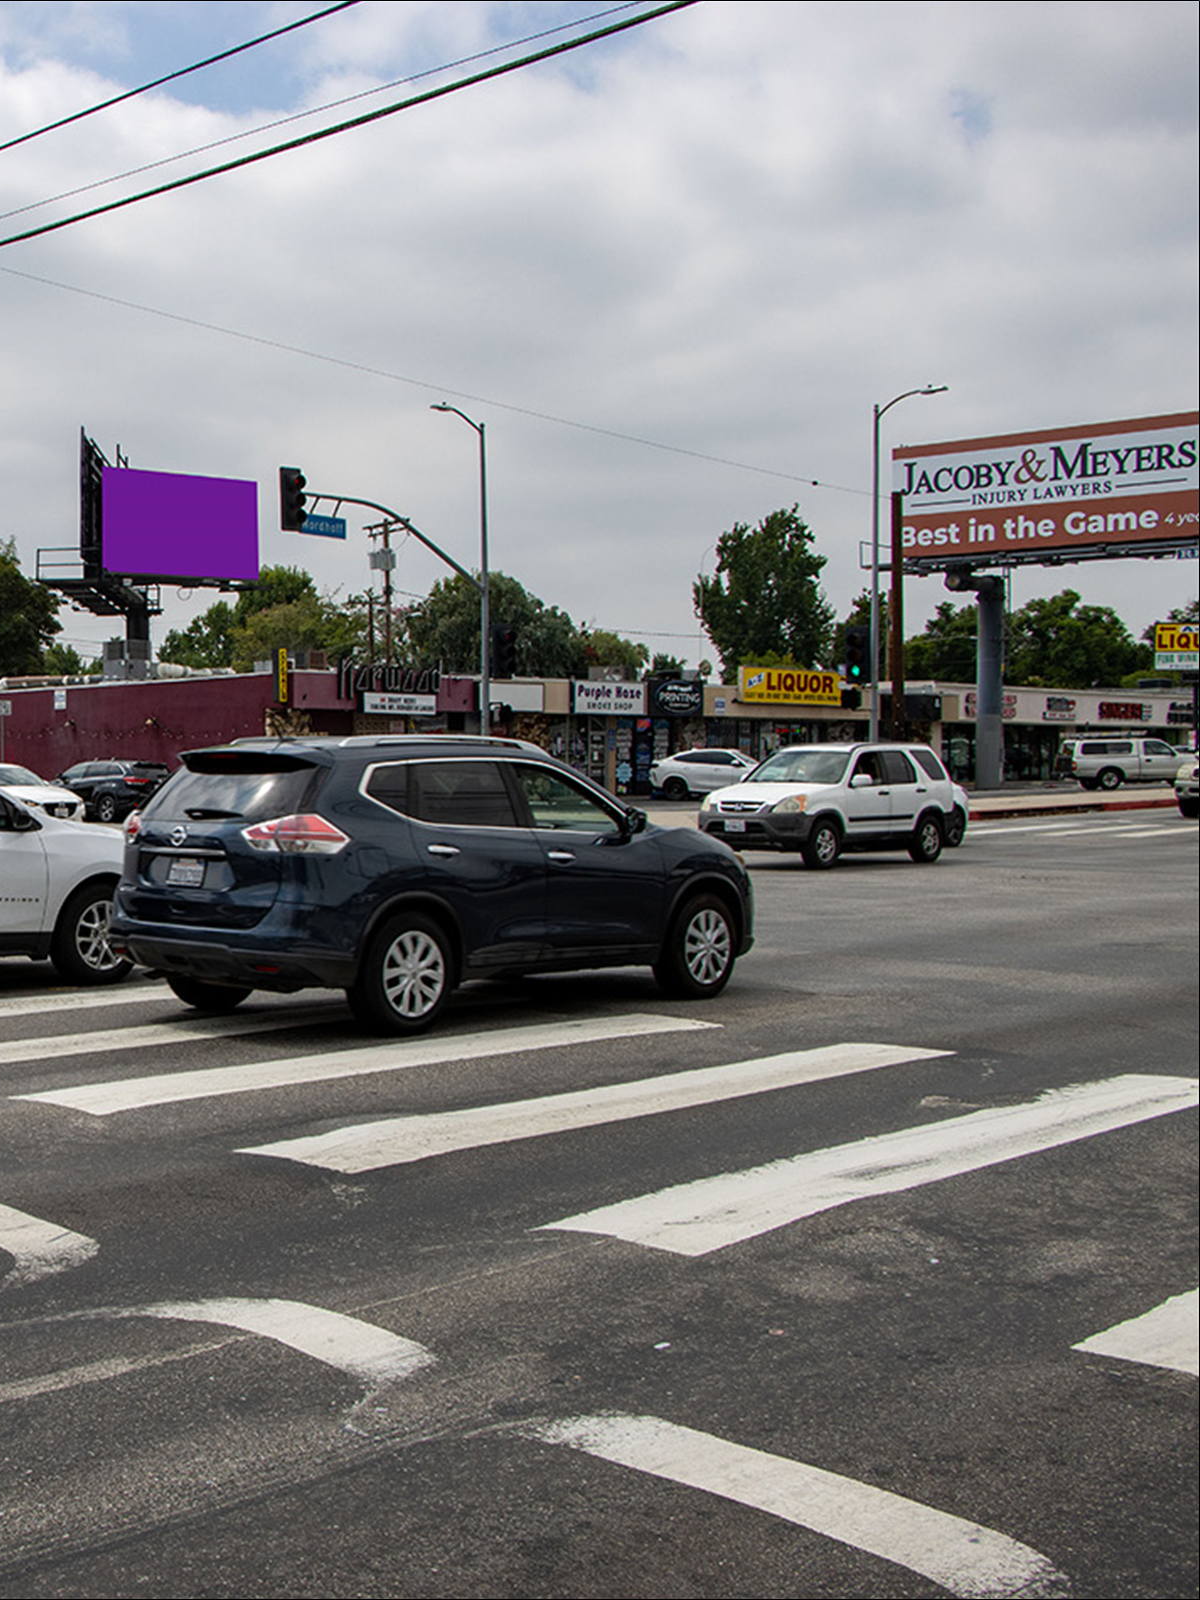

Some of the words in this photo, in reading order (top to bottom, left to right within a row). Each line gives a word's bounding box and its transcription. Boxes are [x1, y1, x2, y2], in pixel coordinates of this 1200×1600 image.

[971, 487, 1028, 506] INJURY
[1033, 480, 1113, 501] LAWYERS
[902, 524, 961, 548] Best
[968, 518, 996, 543] in
[1003, 515, 1057, 541] the
[1064, 509, 1160, 536] Game
[1164, 511, 1175, 525] 4
[577, 684, 612, 700] Purple
[766, 672, 834, 693] LIQUOR
[659, 691, 700, 703] PRINTING
